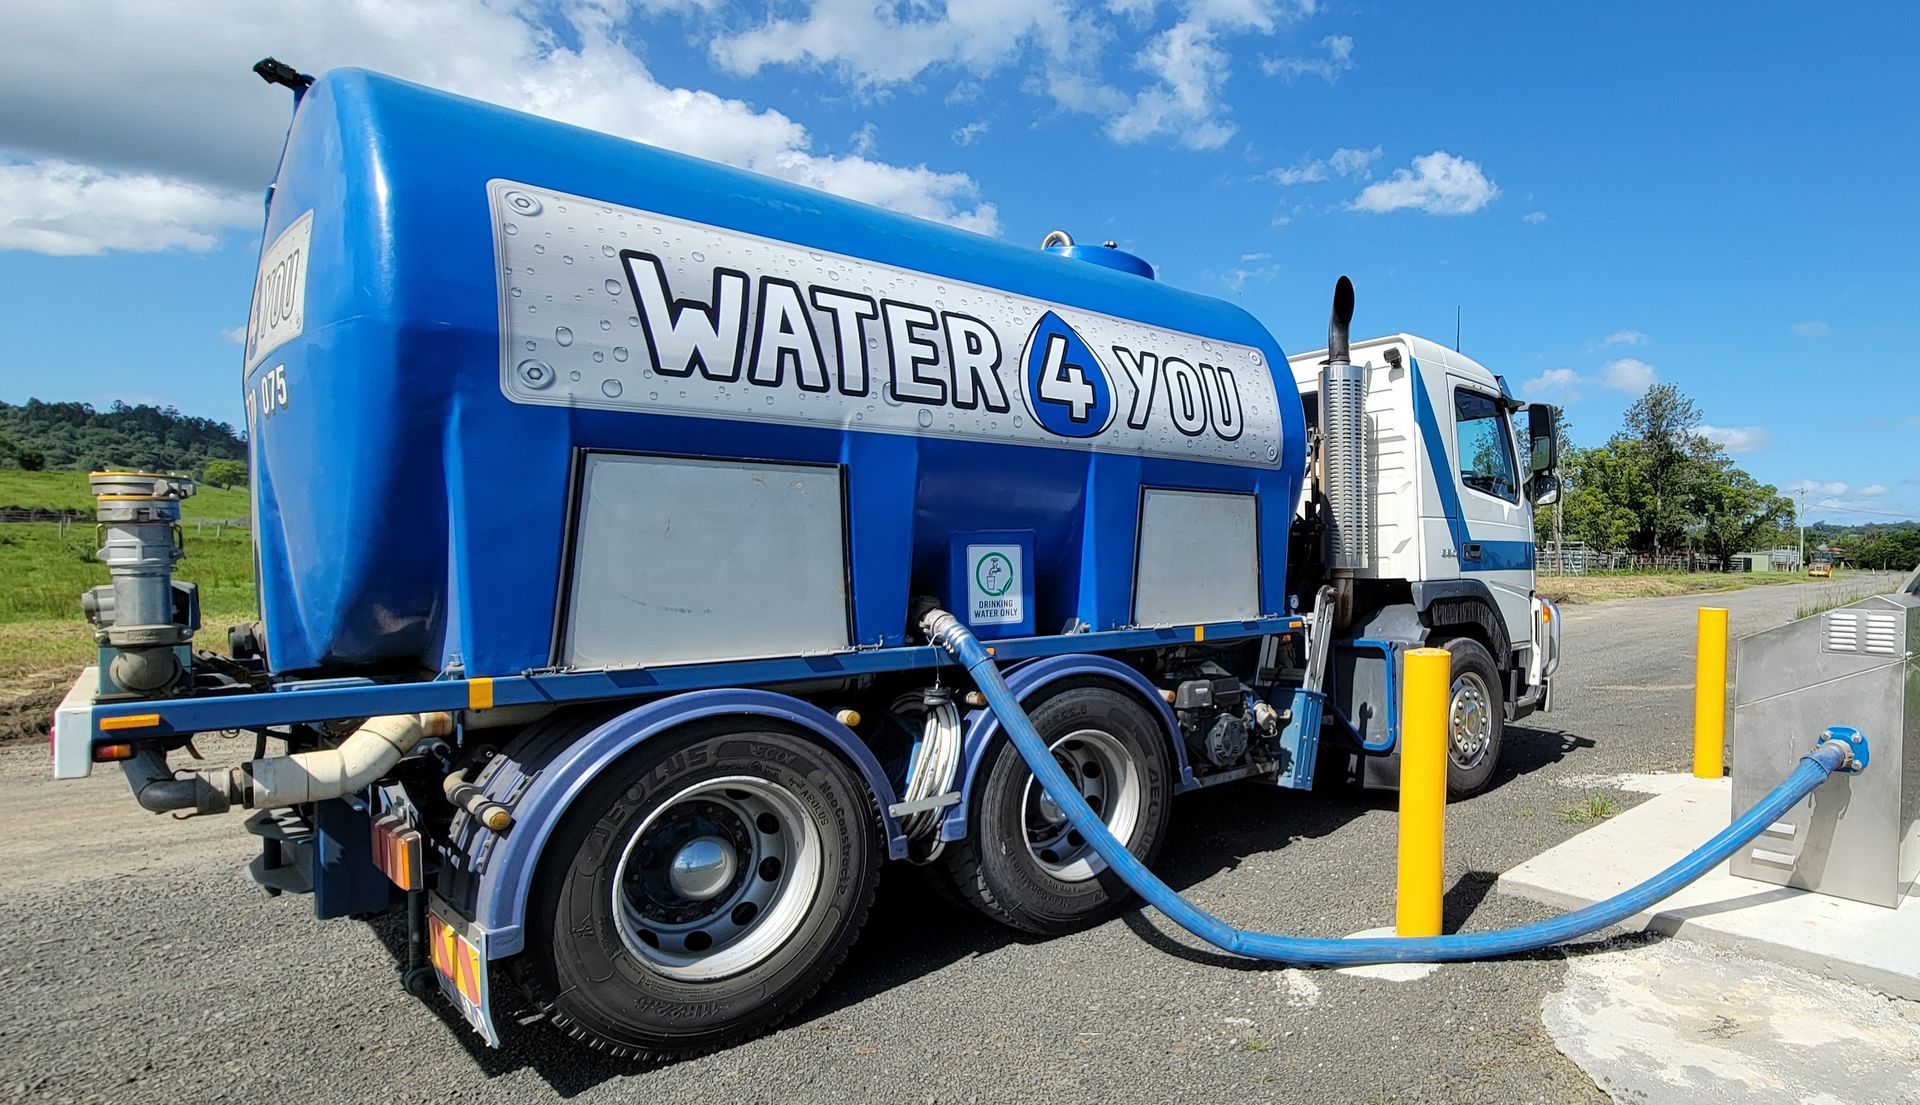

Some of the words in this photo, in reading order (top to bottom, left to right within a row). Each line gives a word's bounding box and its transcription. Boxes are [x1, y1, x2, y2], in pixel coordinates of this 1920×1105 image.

[261, 248, 299, 339] YOU
[620, 249, 1010, 414] WATER
[1036, 332, 1095, 424] 4
[1113, 346, 1245, 440] YOU
[261, 363, 288, 417] 075
[974, 609, 998, 618] WATER
[1000, 608, 1018, 617] ONLY
[979, 600, 1013, 609] DRINKING
[800, 788, 829, 826] AEOLUS
